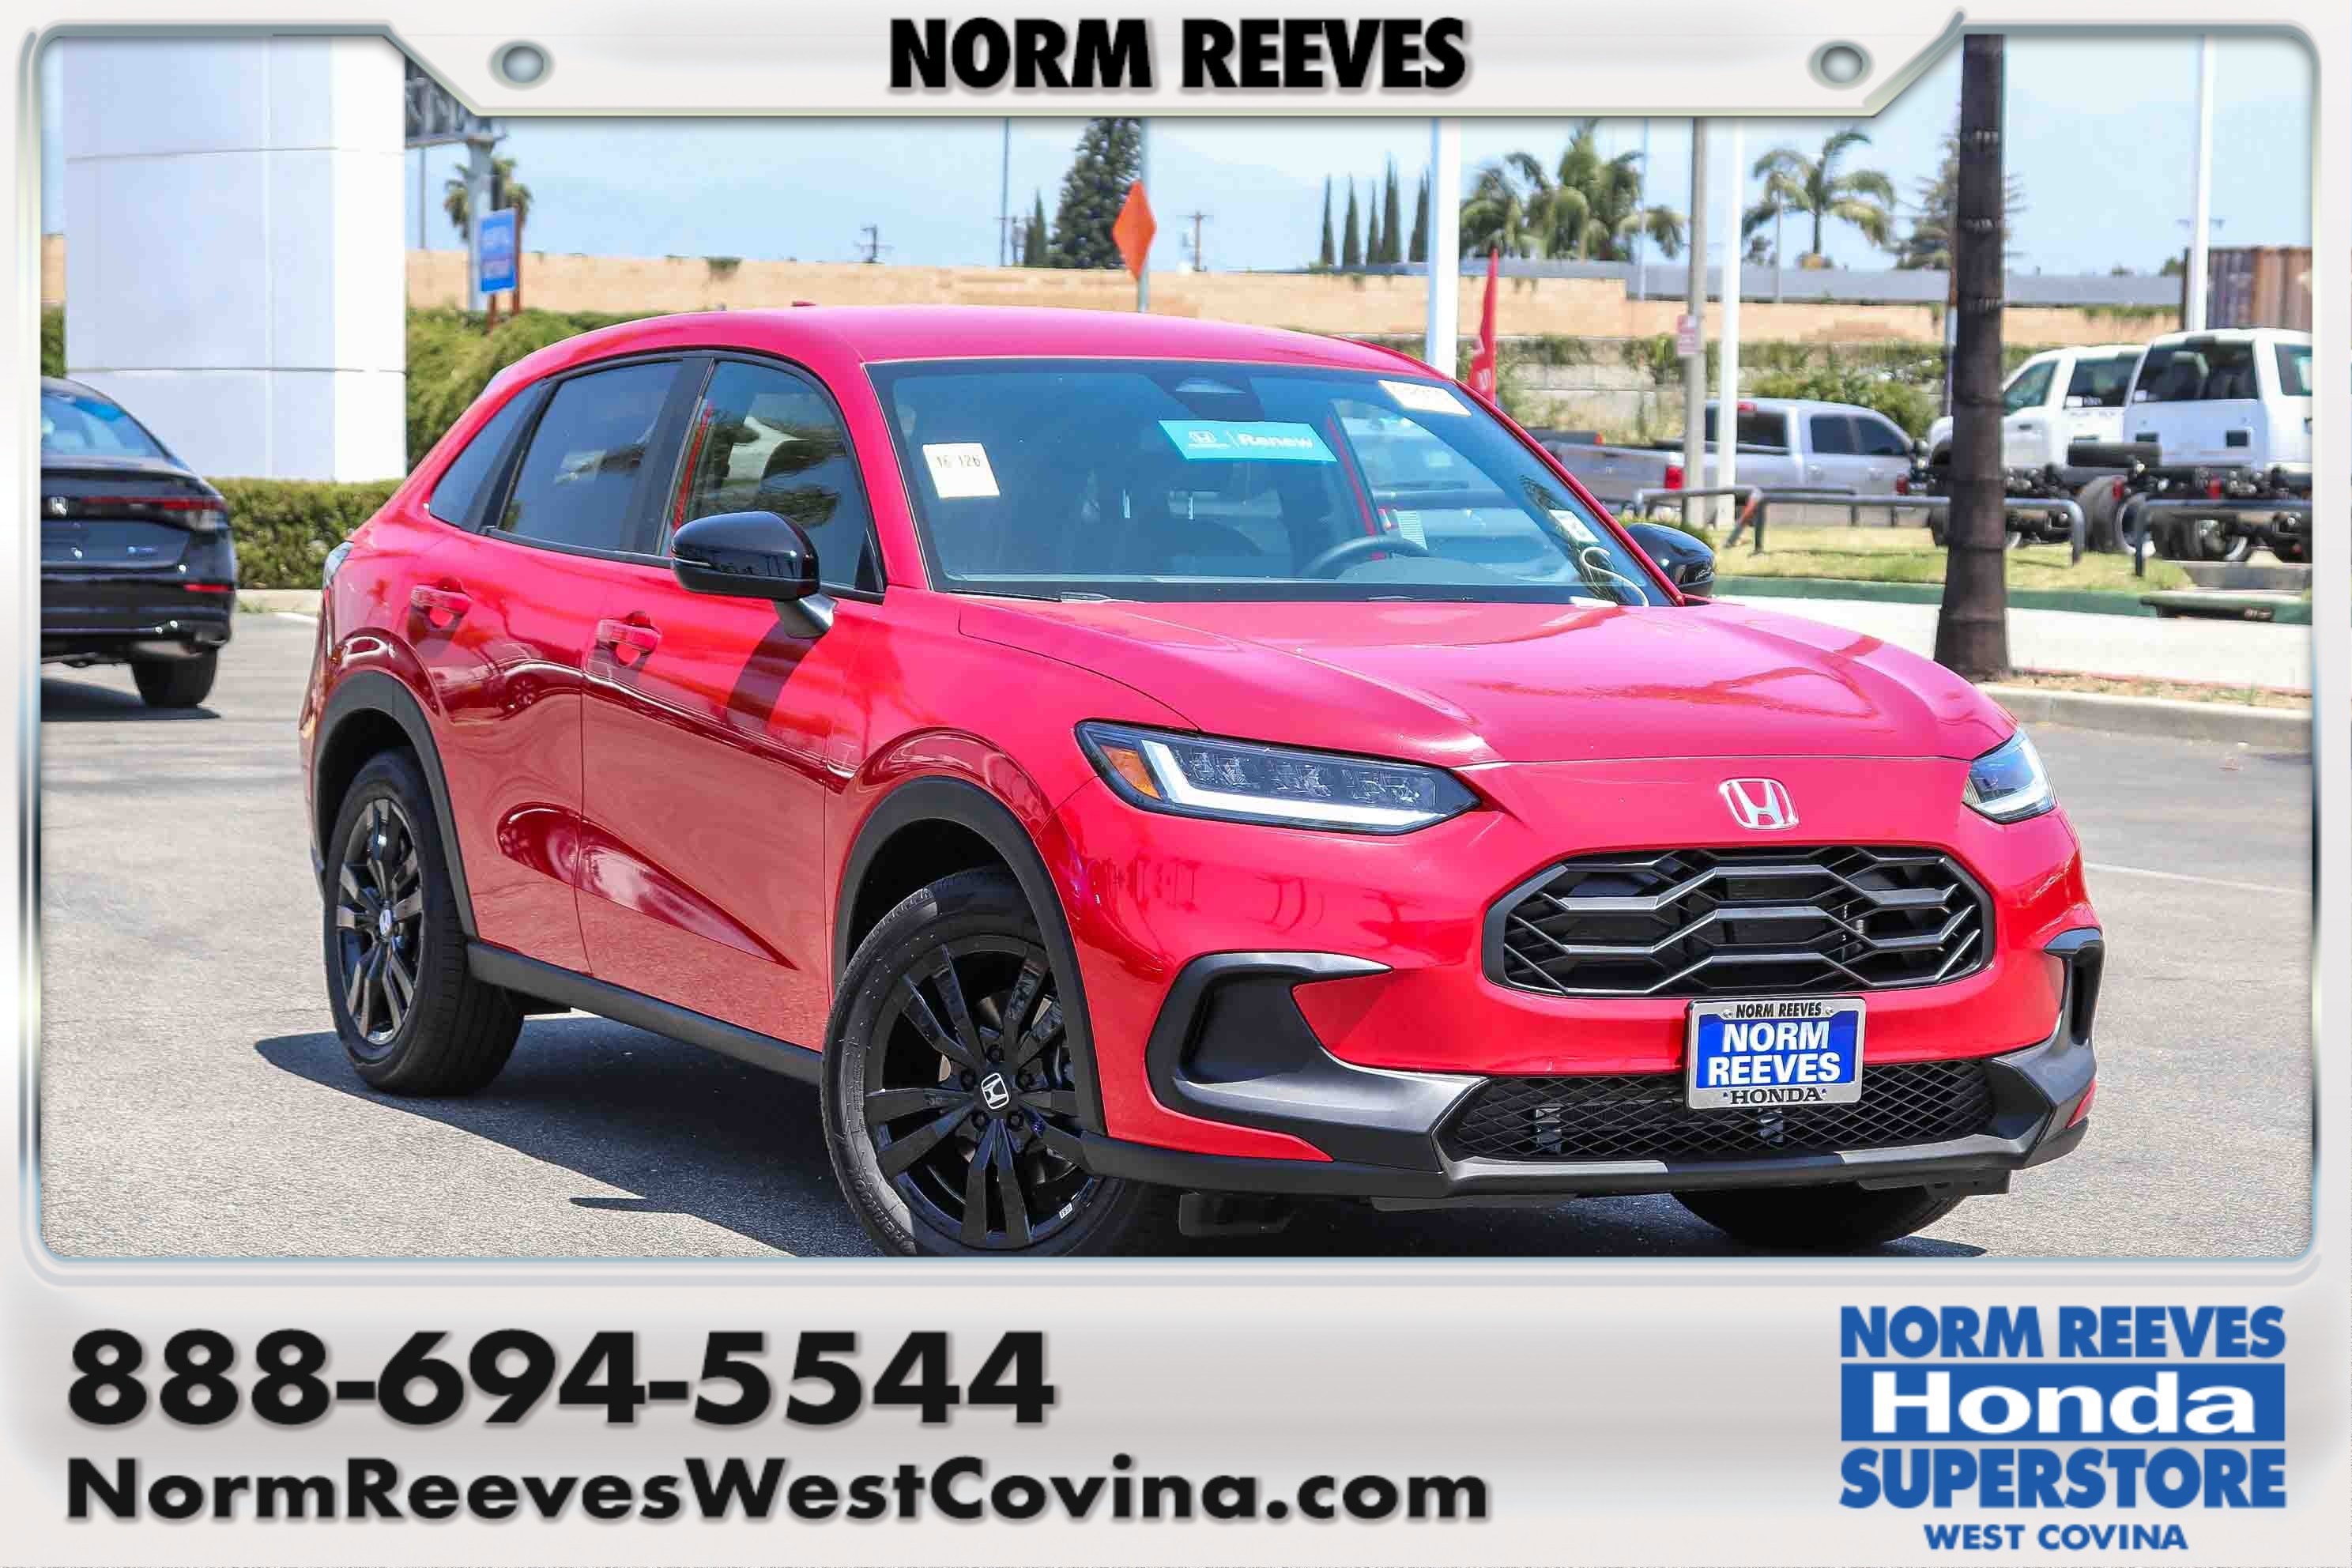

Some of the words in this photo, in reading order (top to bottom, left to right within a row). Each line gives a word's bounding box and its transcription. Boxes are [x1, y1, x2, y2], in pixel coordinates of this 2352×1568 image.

[1736, 1003, 1773, 1019] NORM
[1779, 1002, 1822, 1017] REEVES
[1722, 1020, 1830, 1053] NORM
[1708, 1052, 1841, 1086] REEVES
[1730, 1087, 1823, 1105] HONDA
